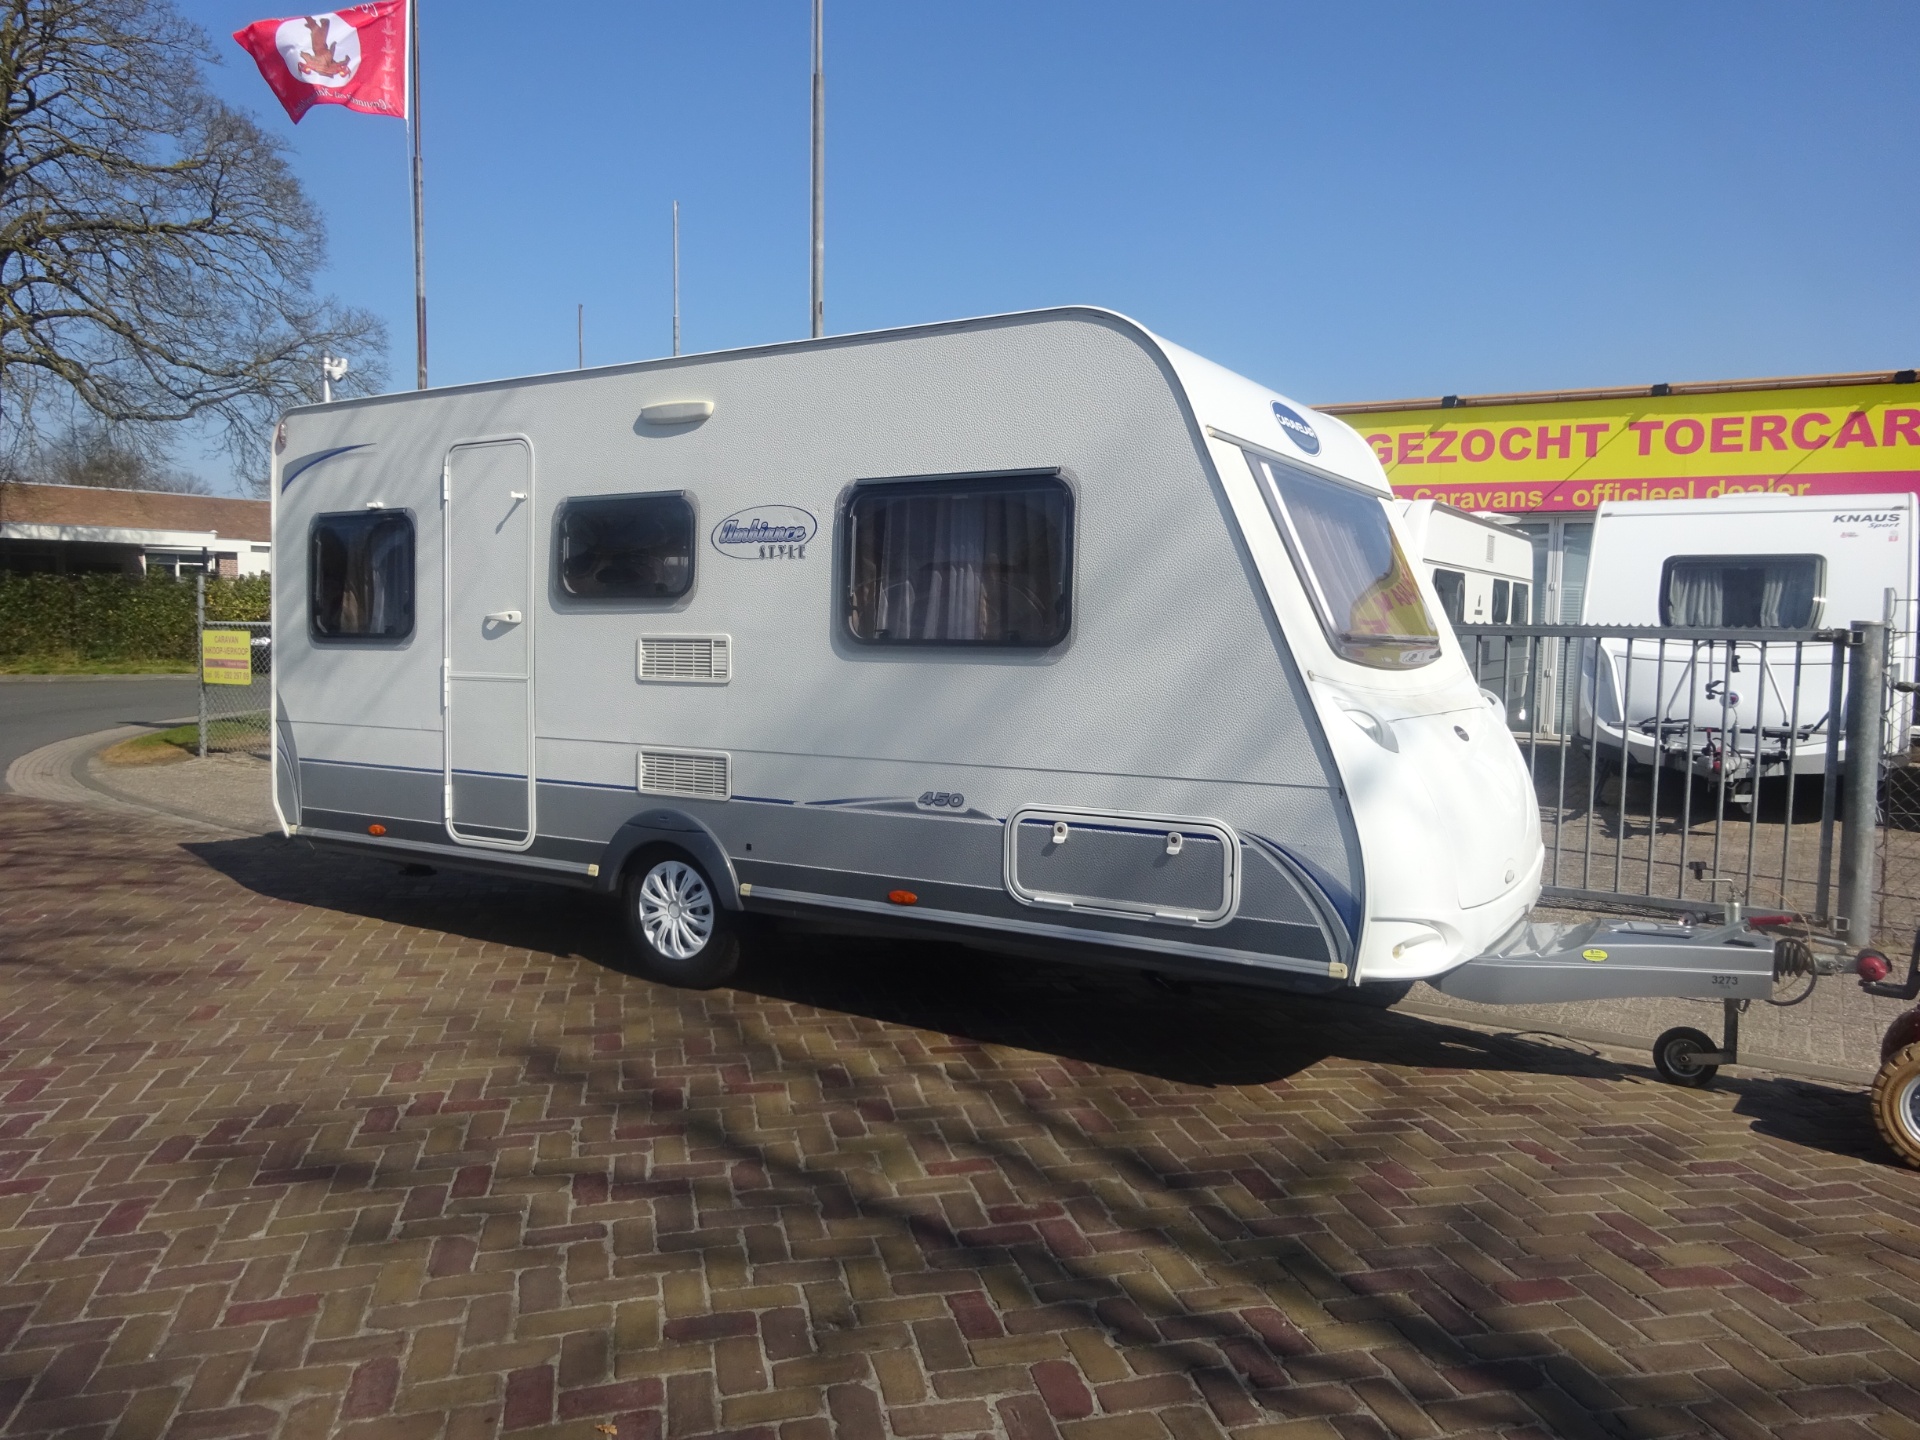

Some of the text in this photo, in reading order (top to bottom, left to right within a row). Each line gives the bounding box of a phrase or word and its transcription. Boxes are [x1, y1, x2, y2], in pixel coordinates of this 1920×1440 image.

[1365, 408, 1920, 466] GEZOCHT TOERCAR
[1572, 480, 1695, 507] officieel
[1833, 514, 1900, 522] KNAUS
[719, 518, 807, 544] Ambiance
[759, 544, 807, 560] STYLE
[214, 635, 239, 643] CARAVAN
[918, 791, 964, 807] 450
[1711, 974, 1738, 986] 3273
